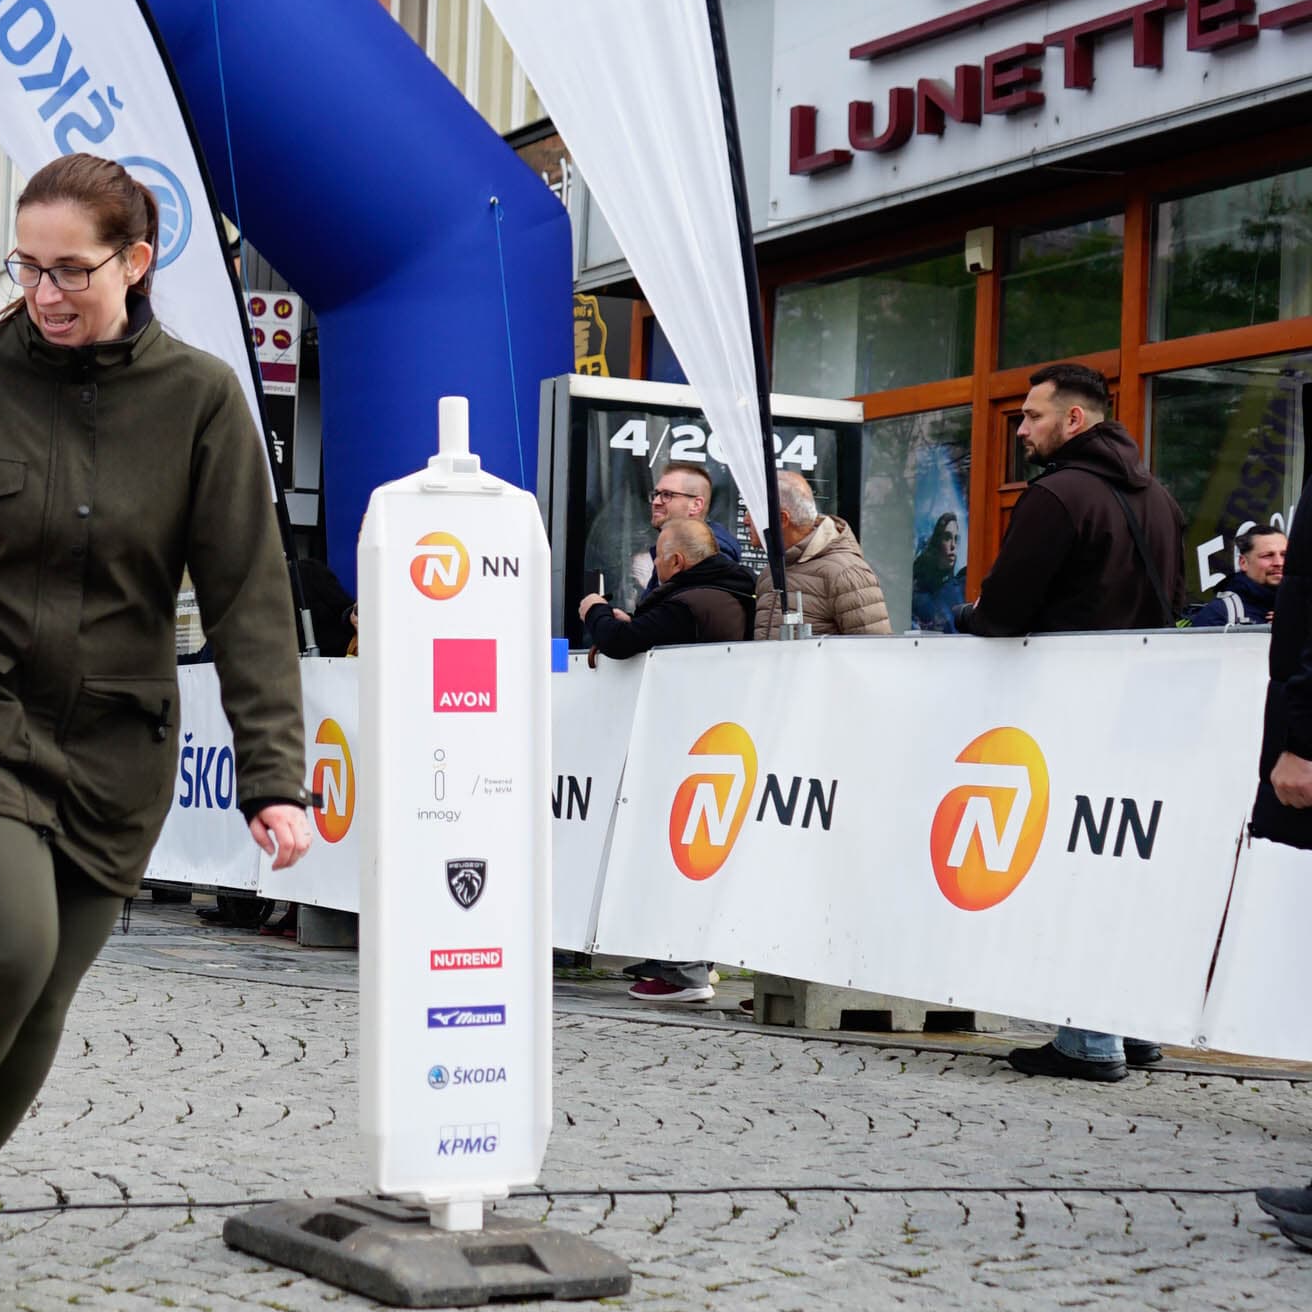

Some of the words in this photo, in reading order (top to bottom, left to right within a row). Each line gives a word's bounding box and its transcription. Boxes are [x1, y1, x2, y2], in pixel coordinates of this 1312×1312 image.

[481, 556, 520, 578] NN
[439, 691, 491, 707] AVON
[179, 732, 240, 811] ŠKO
[756, 773, 838, 831] NN
[417, 807, 462, 823] innogy
[1066, 794, 1163, 860] NN
[433, 952, 501, 967] NUTREND
[452, 1065, 507, 1086] ŠKODA
[438, 1135, 497, 1157] KPMG
